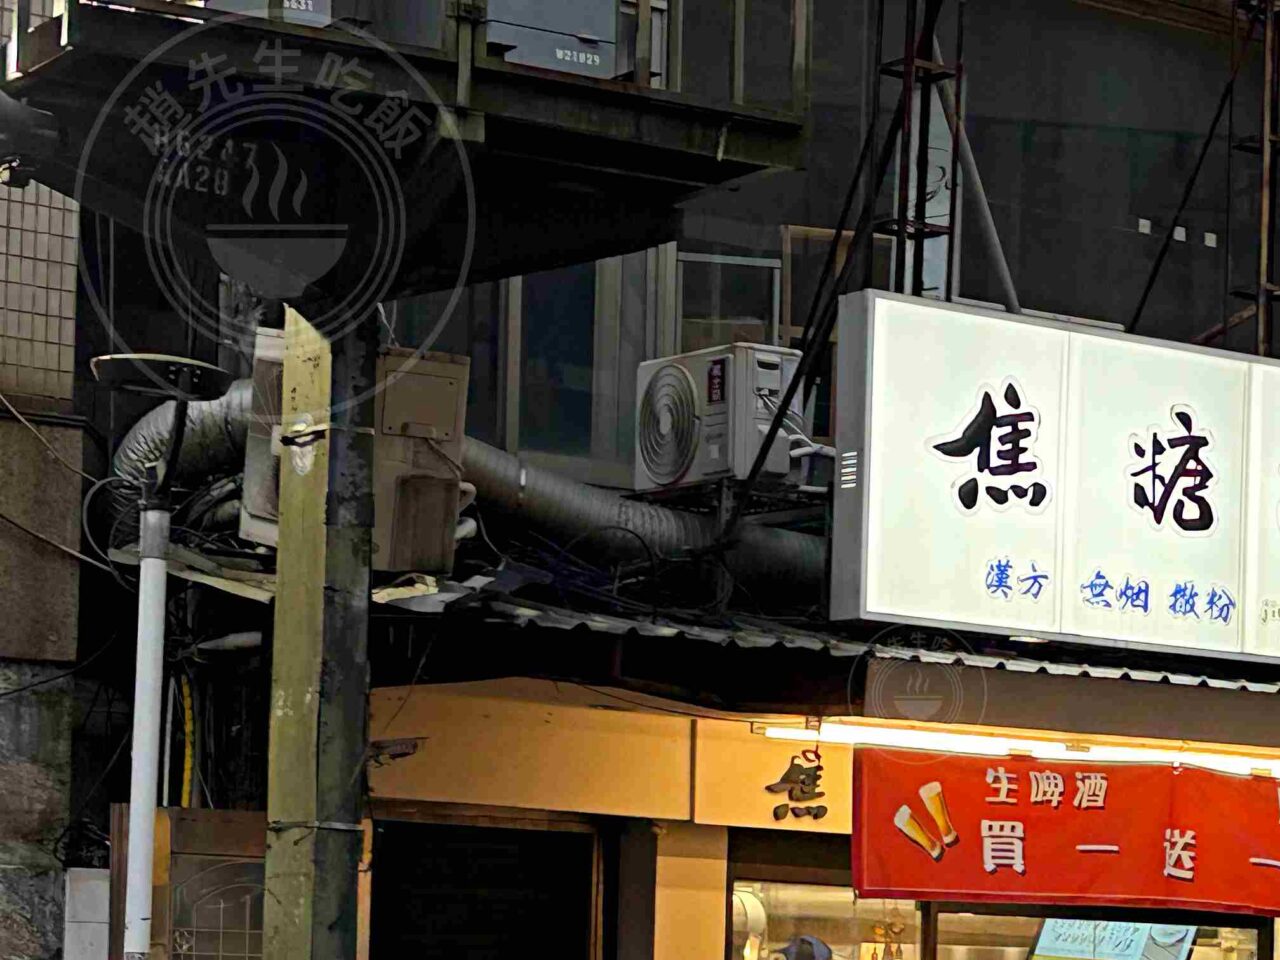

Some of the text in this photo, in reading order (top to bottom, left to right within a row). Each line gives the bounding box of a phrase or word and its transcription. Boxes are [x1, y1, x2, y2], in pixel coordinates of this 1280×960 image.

[985, 559, 1049, 599] 漢方
[765, 753, 828, 821] 焦
[984, 767, 1108, 809] 生啤酒
